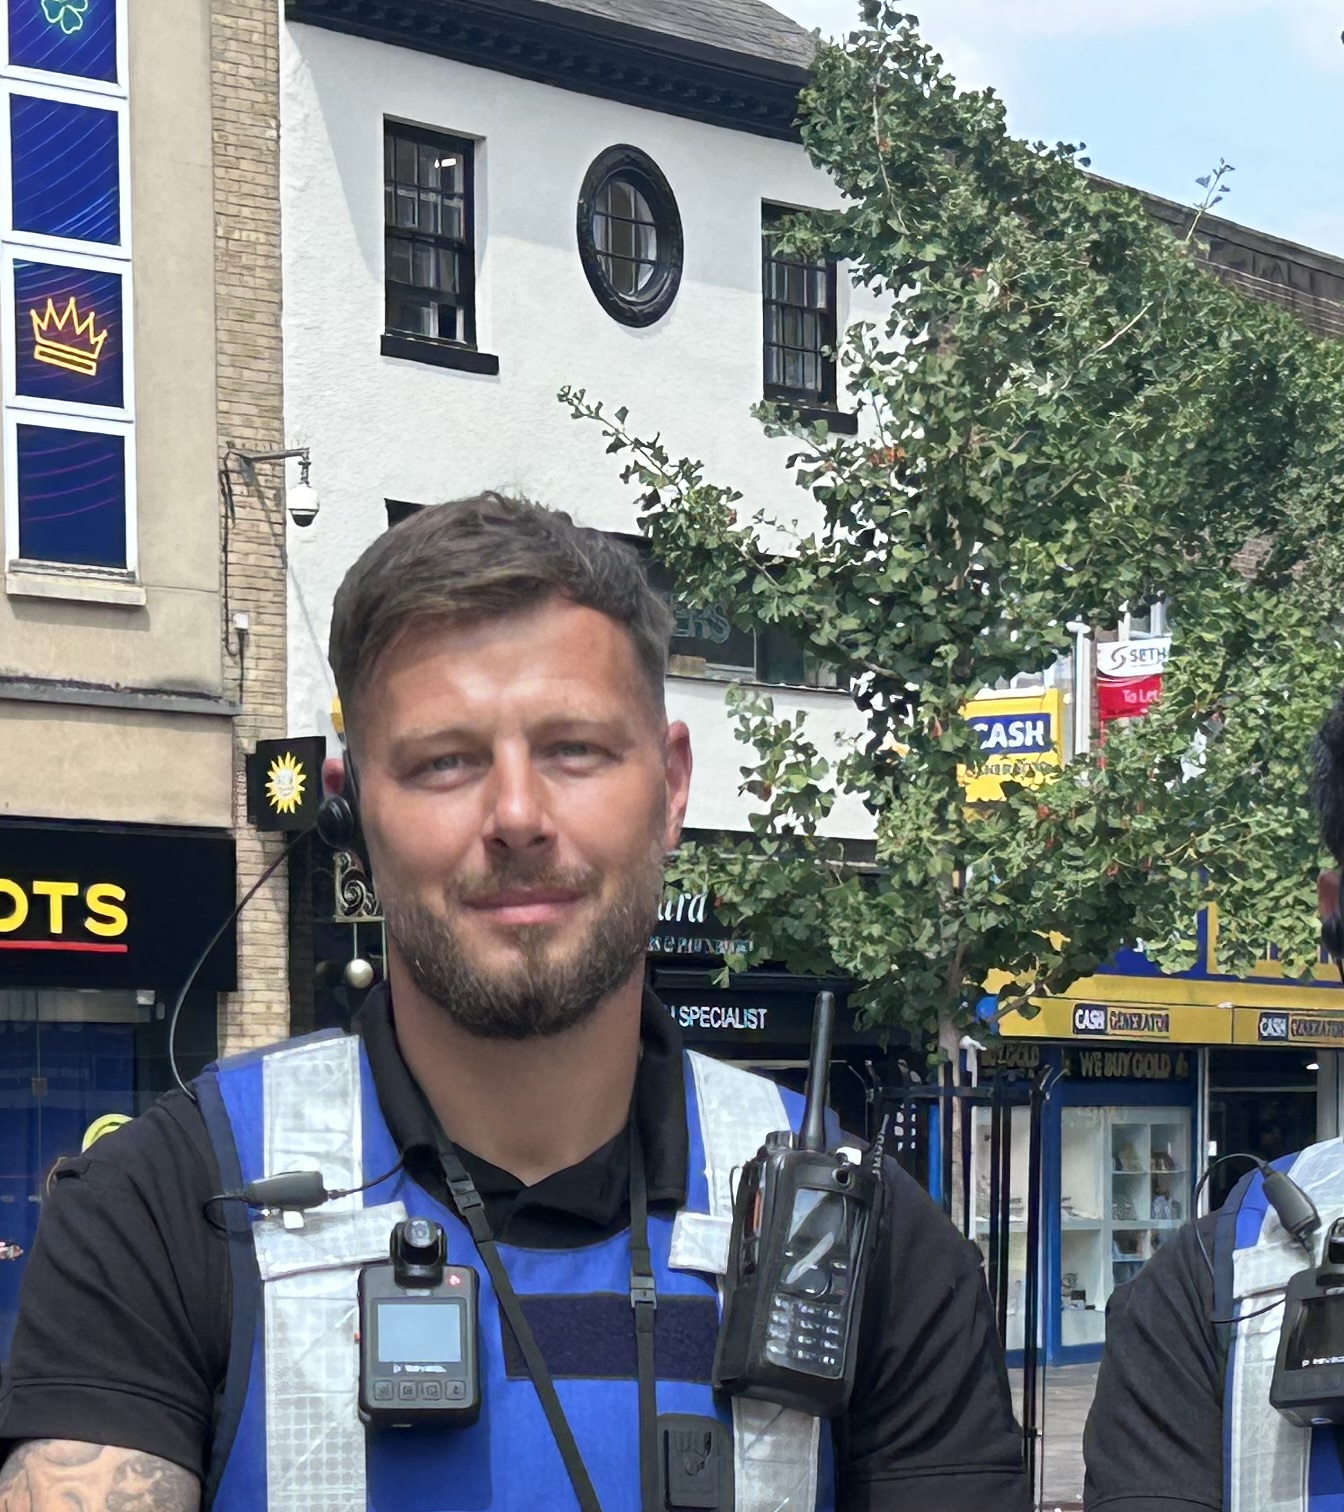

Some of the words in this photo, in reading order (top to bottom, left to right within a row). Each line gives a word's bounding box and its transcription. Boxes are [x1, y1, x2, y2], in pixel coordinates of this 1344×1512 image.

[678, 1005, 768, 1030] SPECIALIST
[1074, 1005, 1106, 1030] CASH
[1259, 1016, 1287, 1038] CASH
[1103, 1051, 1129, 1077] BUY
[1132, 1052, 1171, 1078] GOLD
